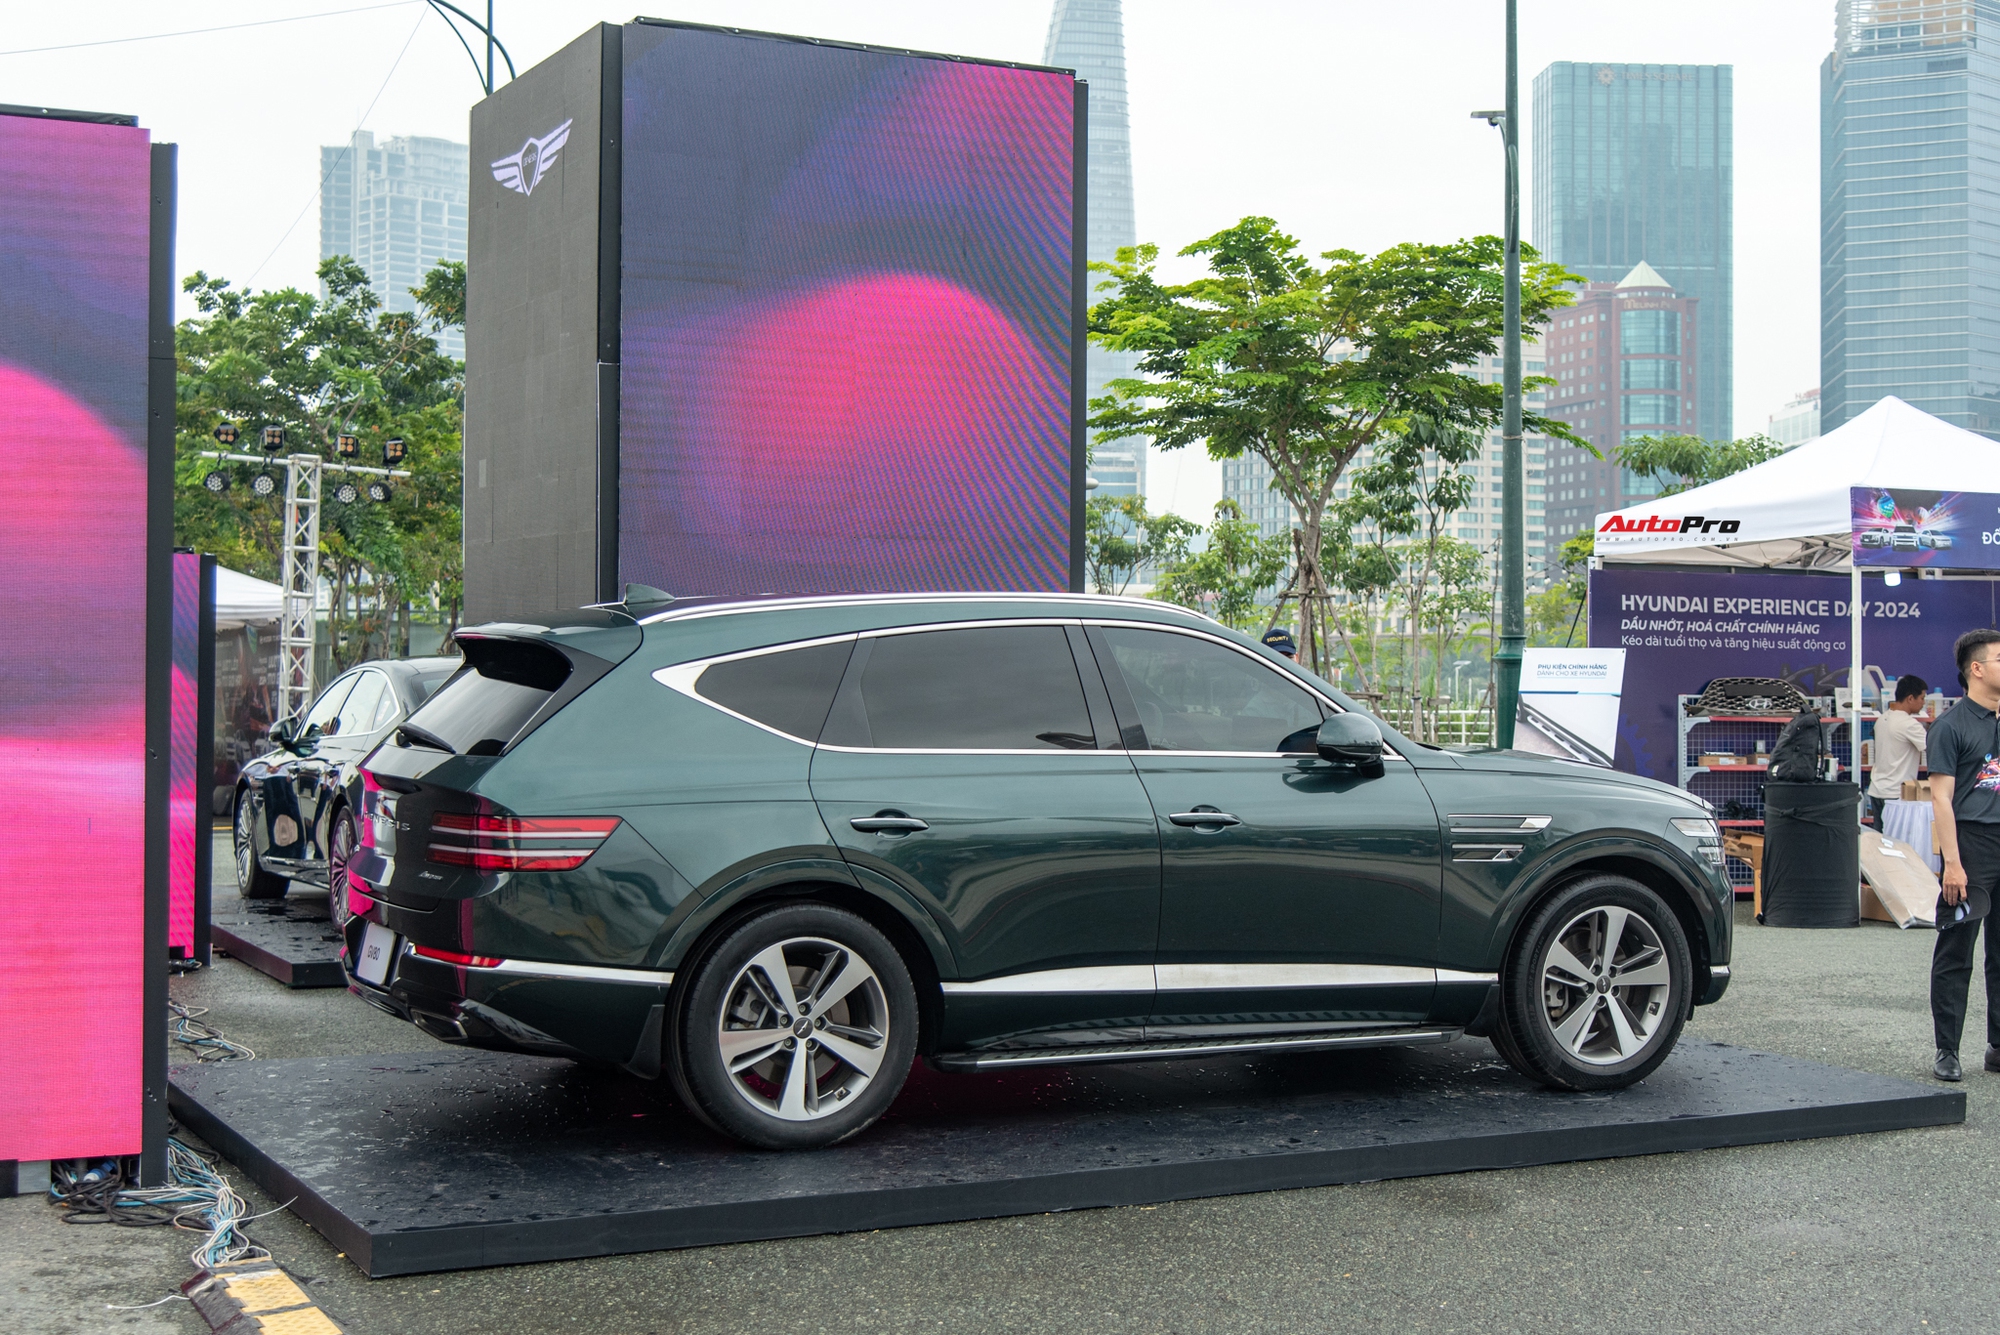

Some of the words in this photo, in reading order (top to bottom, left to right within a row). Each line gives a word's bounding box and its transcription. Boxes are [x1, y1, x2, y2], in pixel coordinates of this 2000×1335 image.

[1621, 594, 1708, 613] HYUNDAI
[1713, 597, 1829, 617] EXPERIENCE
[1874, 601, 1921, 618] 2024
[1649, 617, 1684, 633] NHỚT,
[1686, 618, 1713, 632] HOÁ
[1715, 618, 1747, 633] CHẤT
[1747, 620, 1784, 634] CHÍNH
[1786, 621, 1820, 635] HÃNG
[1621, 634, 1643, 646] Kéo
[1645, 635, 1662, 647] dài
[1664, 634, 1686, 647] tuổi
[1688, 637, 1707, 650] thọ
[1709, 637, 1722, 648] và
[1724, 637, 1750, 651] tăng
[1752, 638, 1775, 650] hiệu
[1777, 638, 1801, 649] suất
[1803, 638, 1831, 652] động
[1833, 641, 1846, 650] cơ
